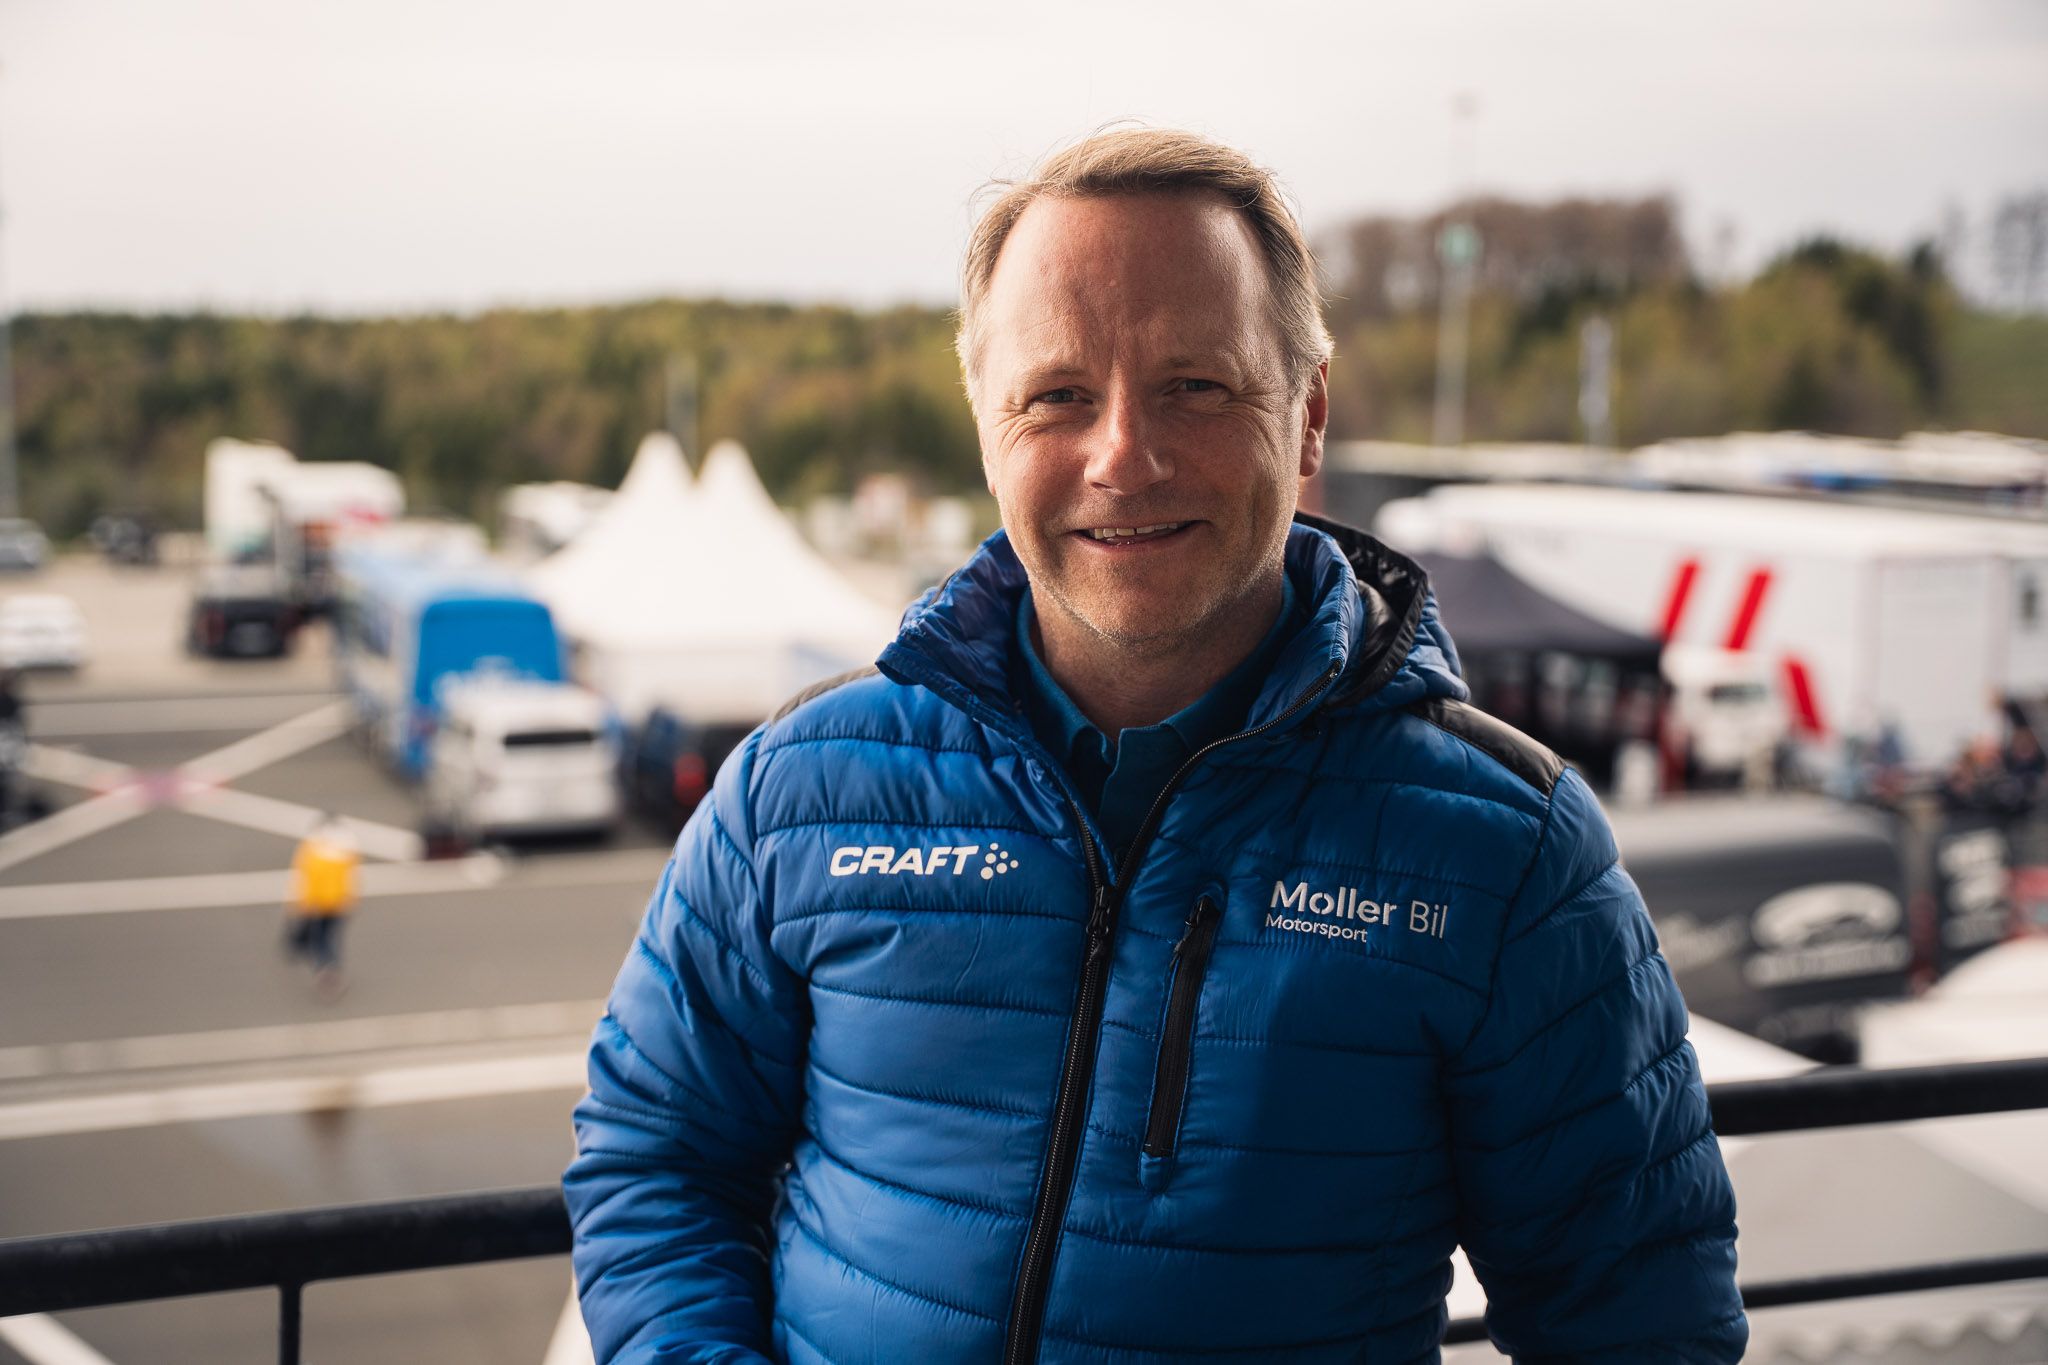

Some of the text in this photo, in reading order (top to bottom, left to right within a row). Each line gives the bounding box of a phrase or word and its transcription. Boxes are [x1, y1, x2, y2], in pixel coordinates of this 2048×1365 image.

[829, 845, 980, 877] CRAFT
[1265, 913, 1368, 943] Motorsport
[1409, 899, 1449, 939] Bil
